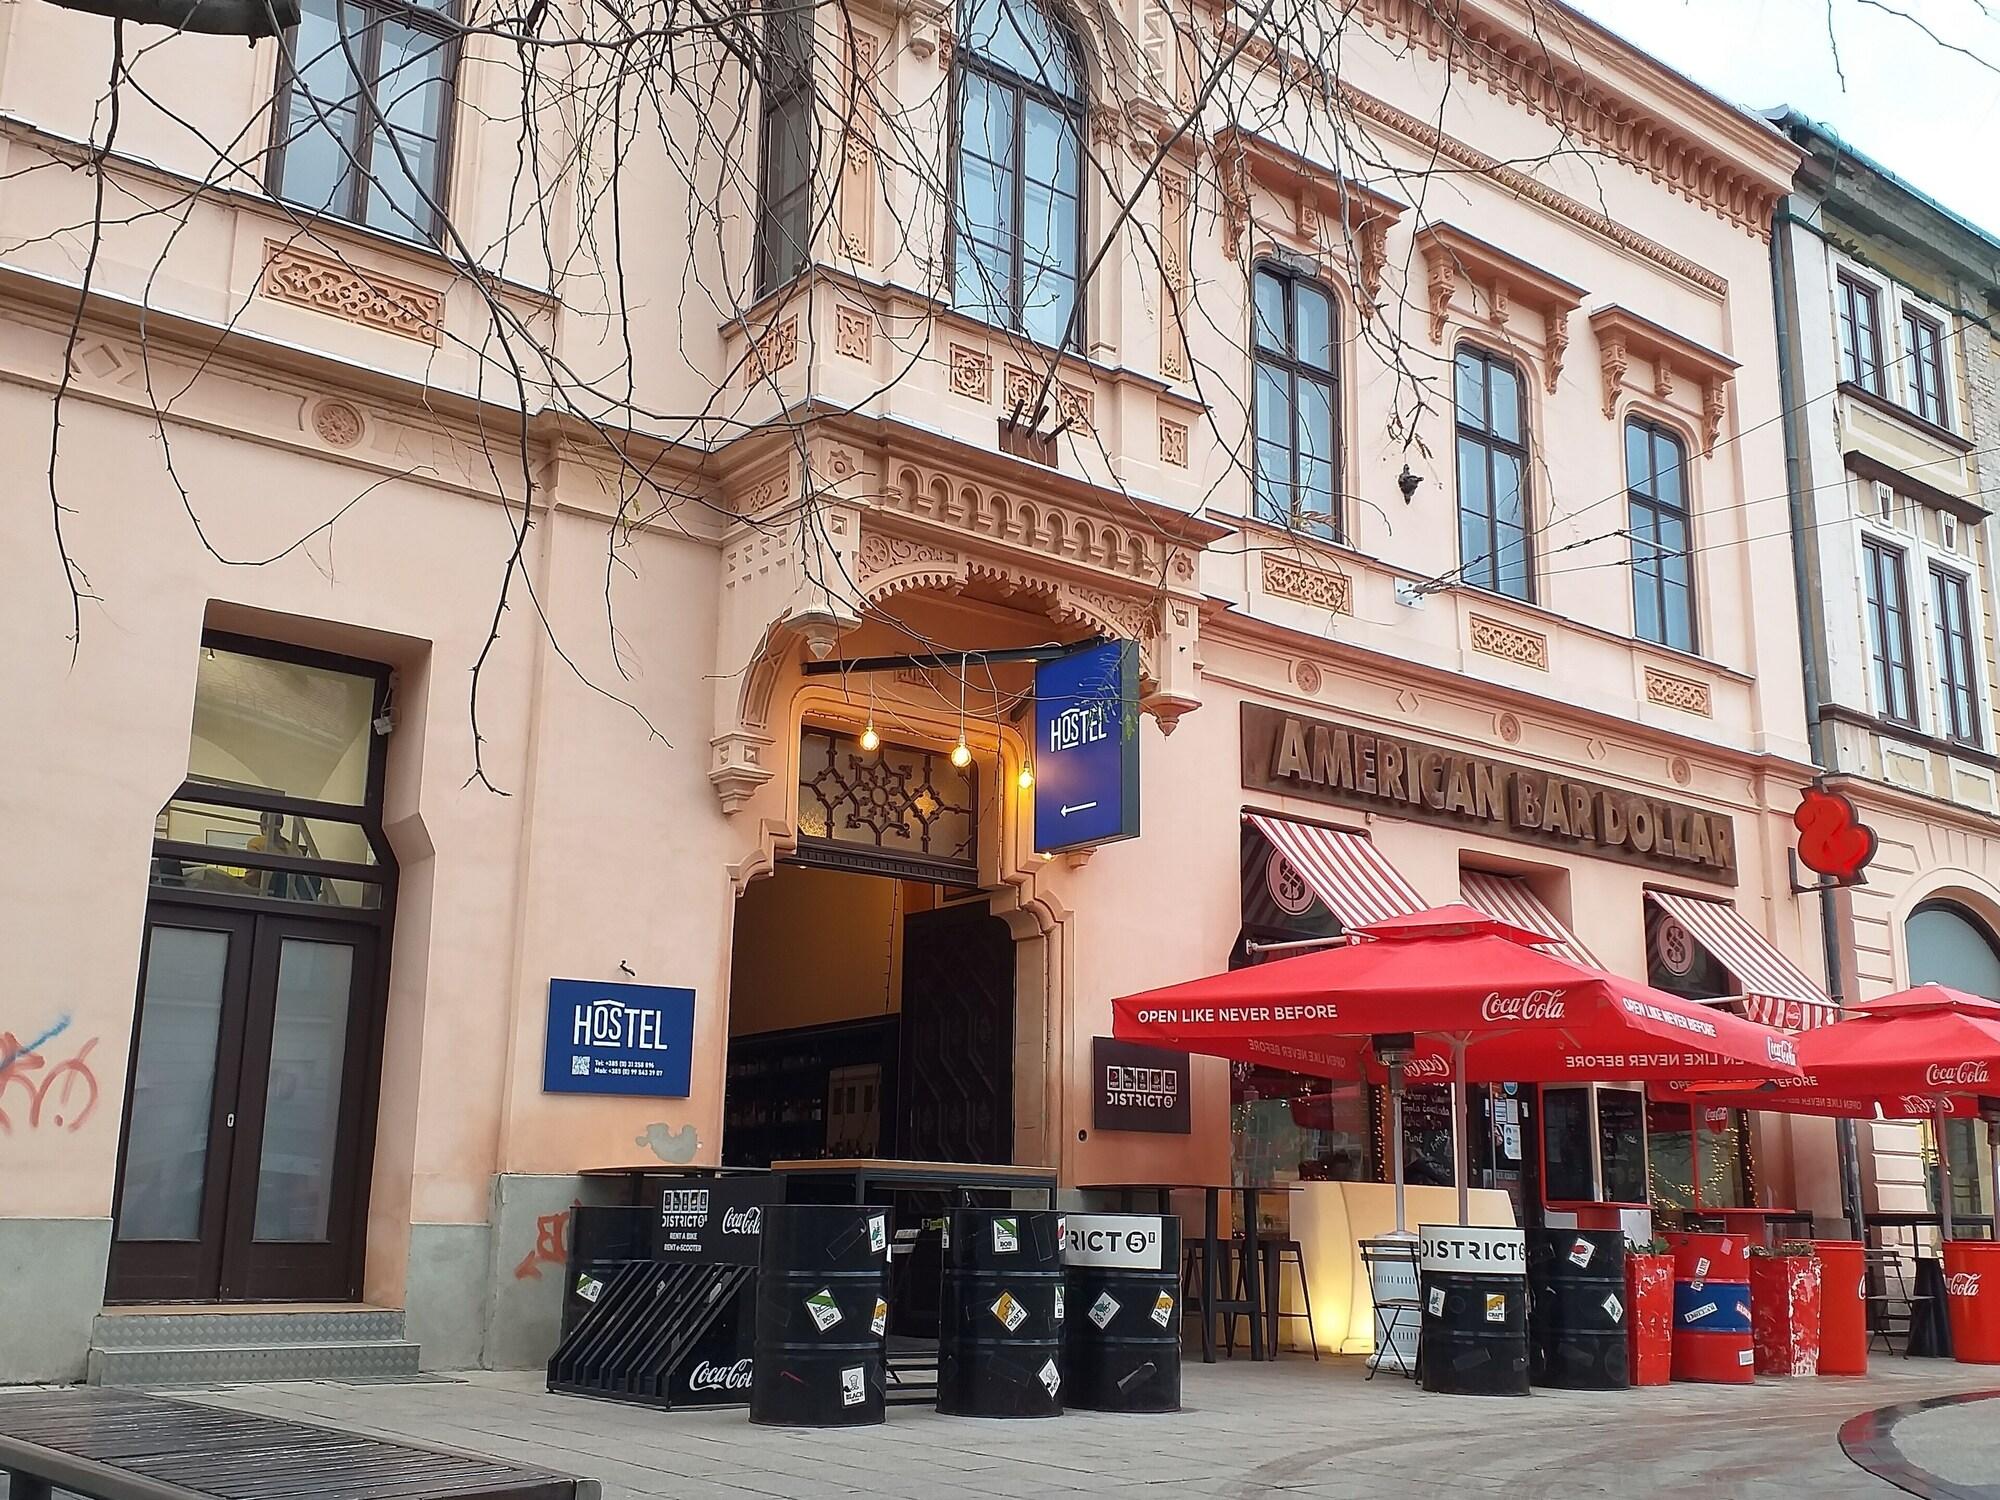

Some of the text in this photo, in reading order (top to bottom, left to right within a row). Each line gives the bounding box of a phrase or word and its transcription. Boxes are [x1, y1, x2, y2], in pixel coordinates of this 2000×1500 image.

[1050, 706, 1107, 752] HOSTEL
[1277, 717, 1735, 870] AMERICAN BAR DOLLAR
[1137, 1005, 1338, 1023] OPEN LIKE NEVER BEFORE
[573, 1003, 668, 1050] HOSTEL
[1106, 1092, 1163, 1108] DISTRICT
[662, 1215, 698, 1227] DISTRICT
[1422, 1239, 1518, 1261] DISTRICT
